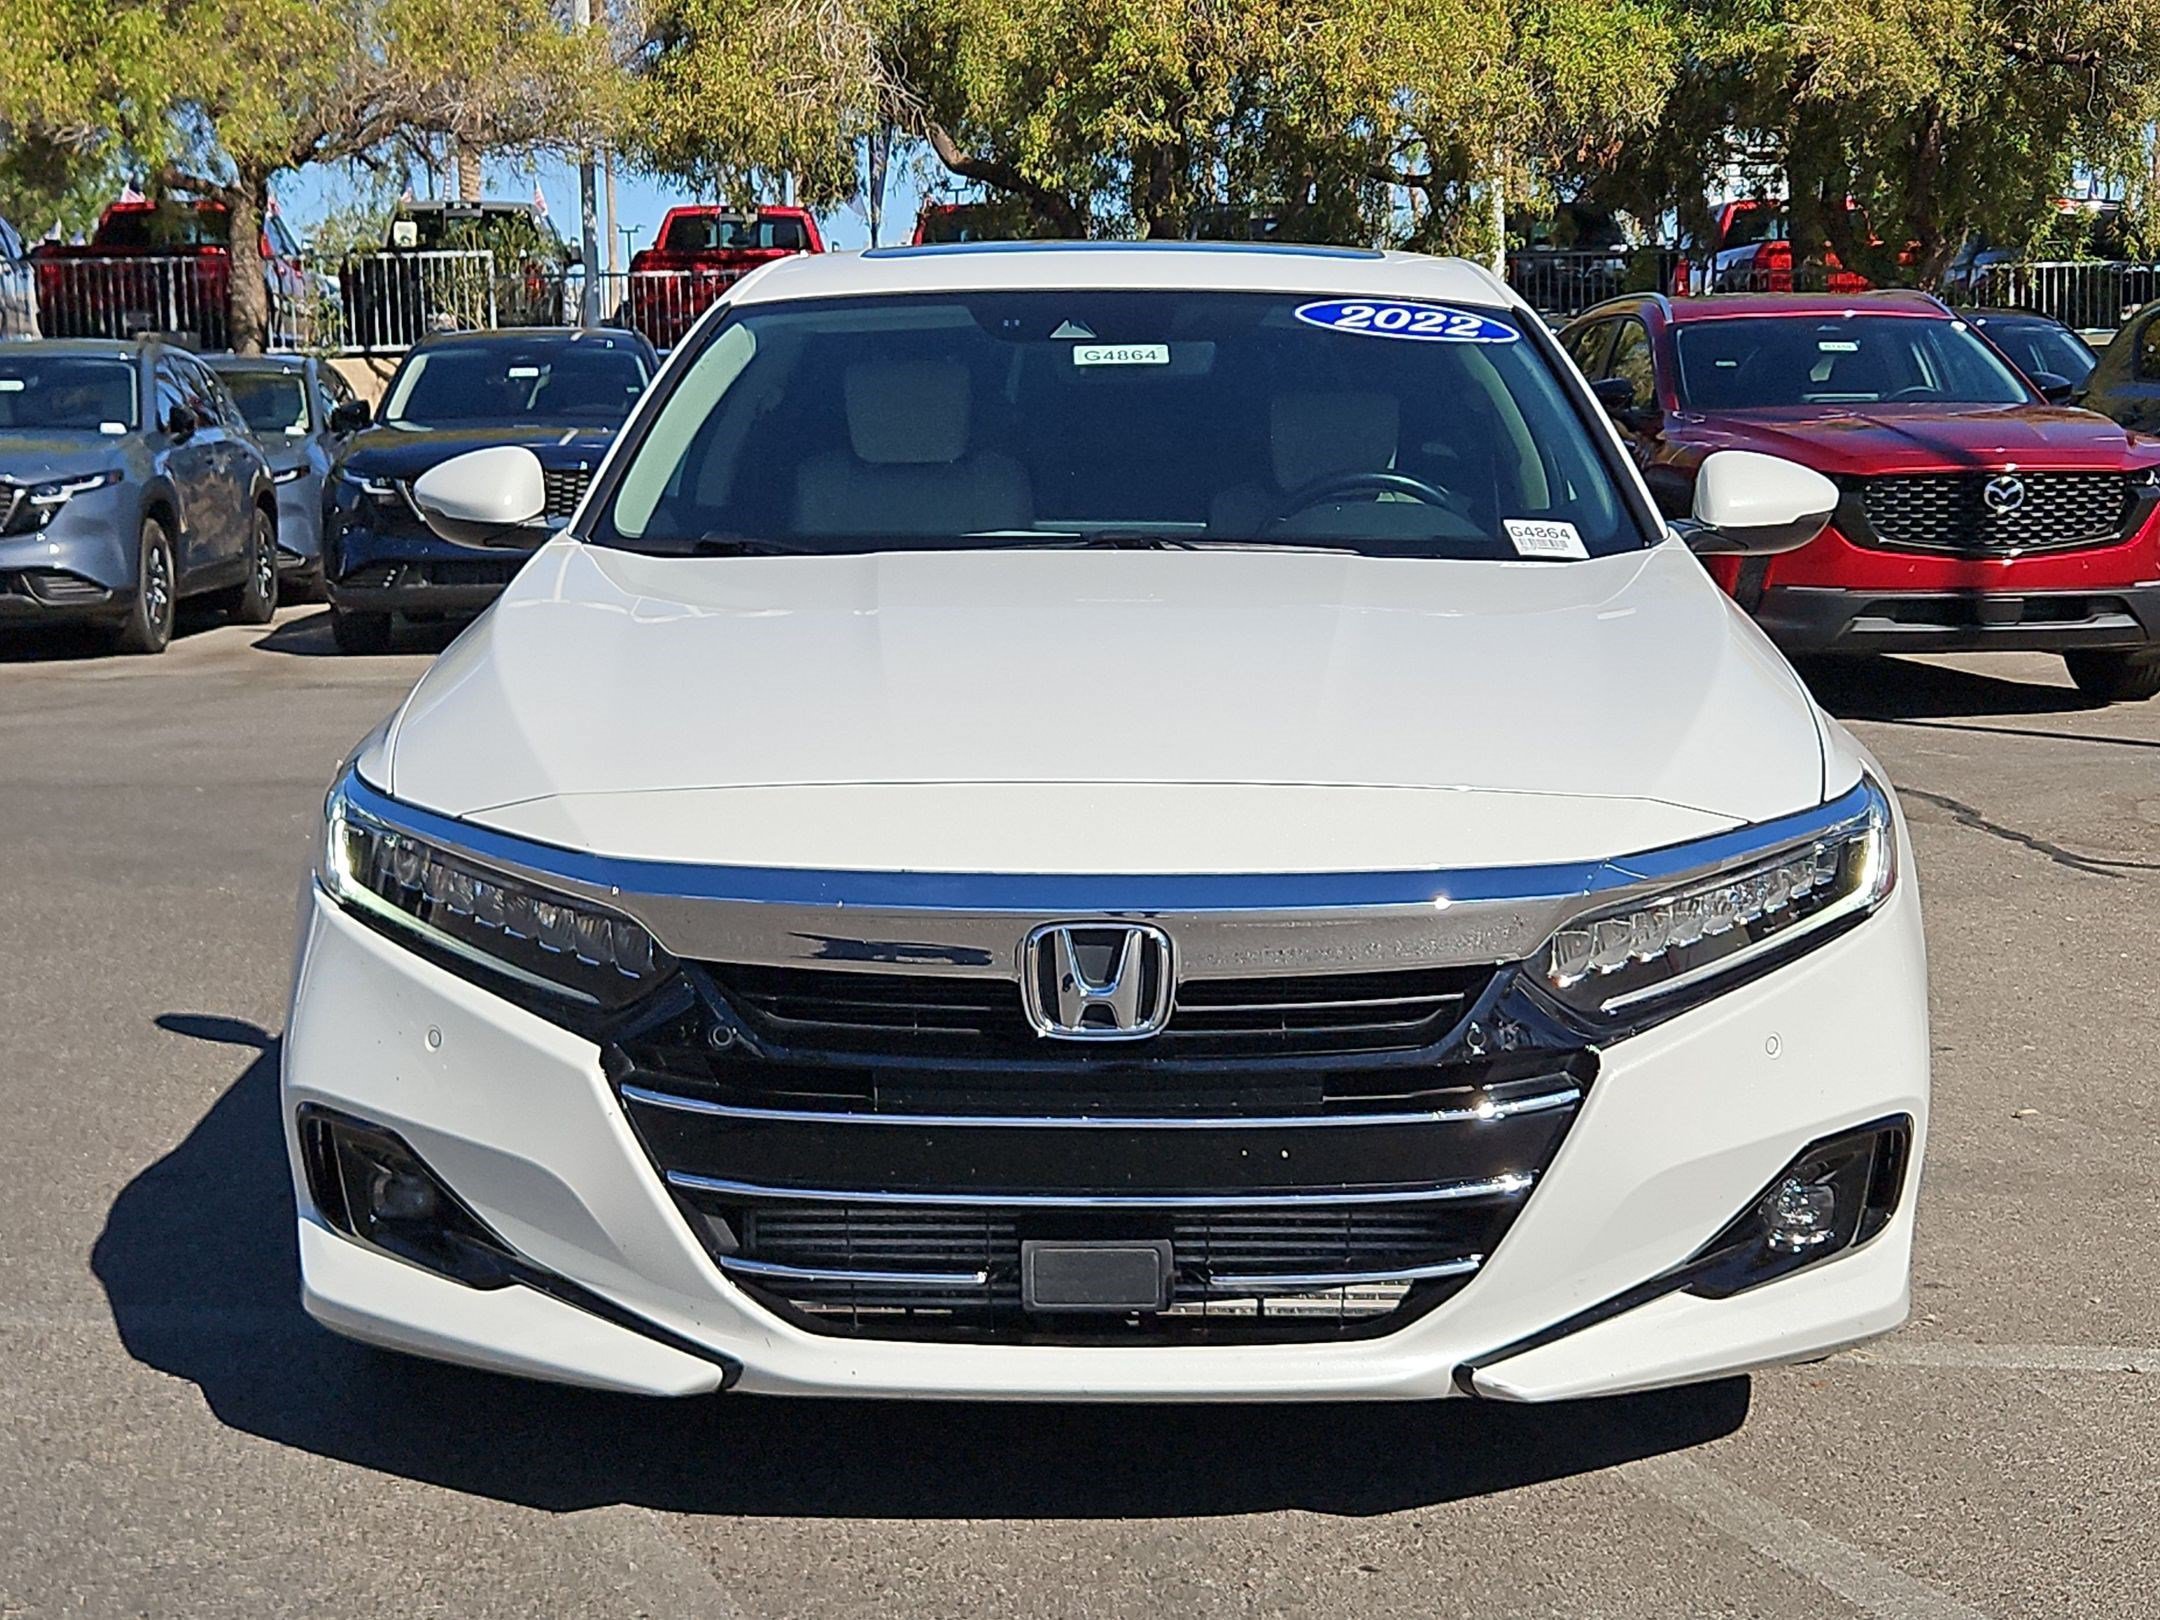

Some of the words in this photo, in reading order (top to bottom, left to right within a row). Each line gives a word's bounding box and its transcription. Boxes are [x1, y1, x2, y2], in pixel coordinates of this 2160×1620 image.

[1334, 305, 1483, 337] 2022
[1084, 350, 1158, 361] G4864
[1510, 526, 1571, 540] G4864
